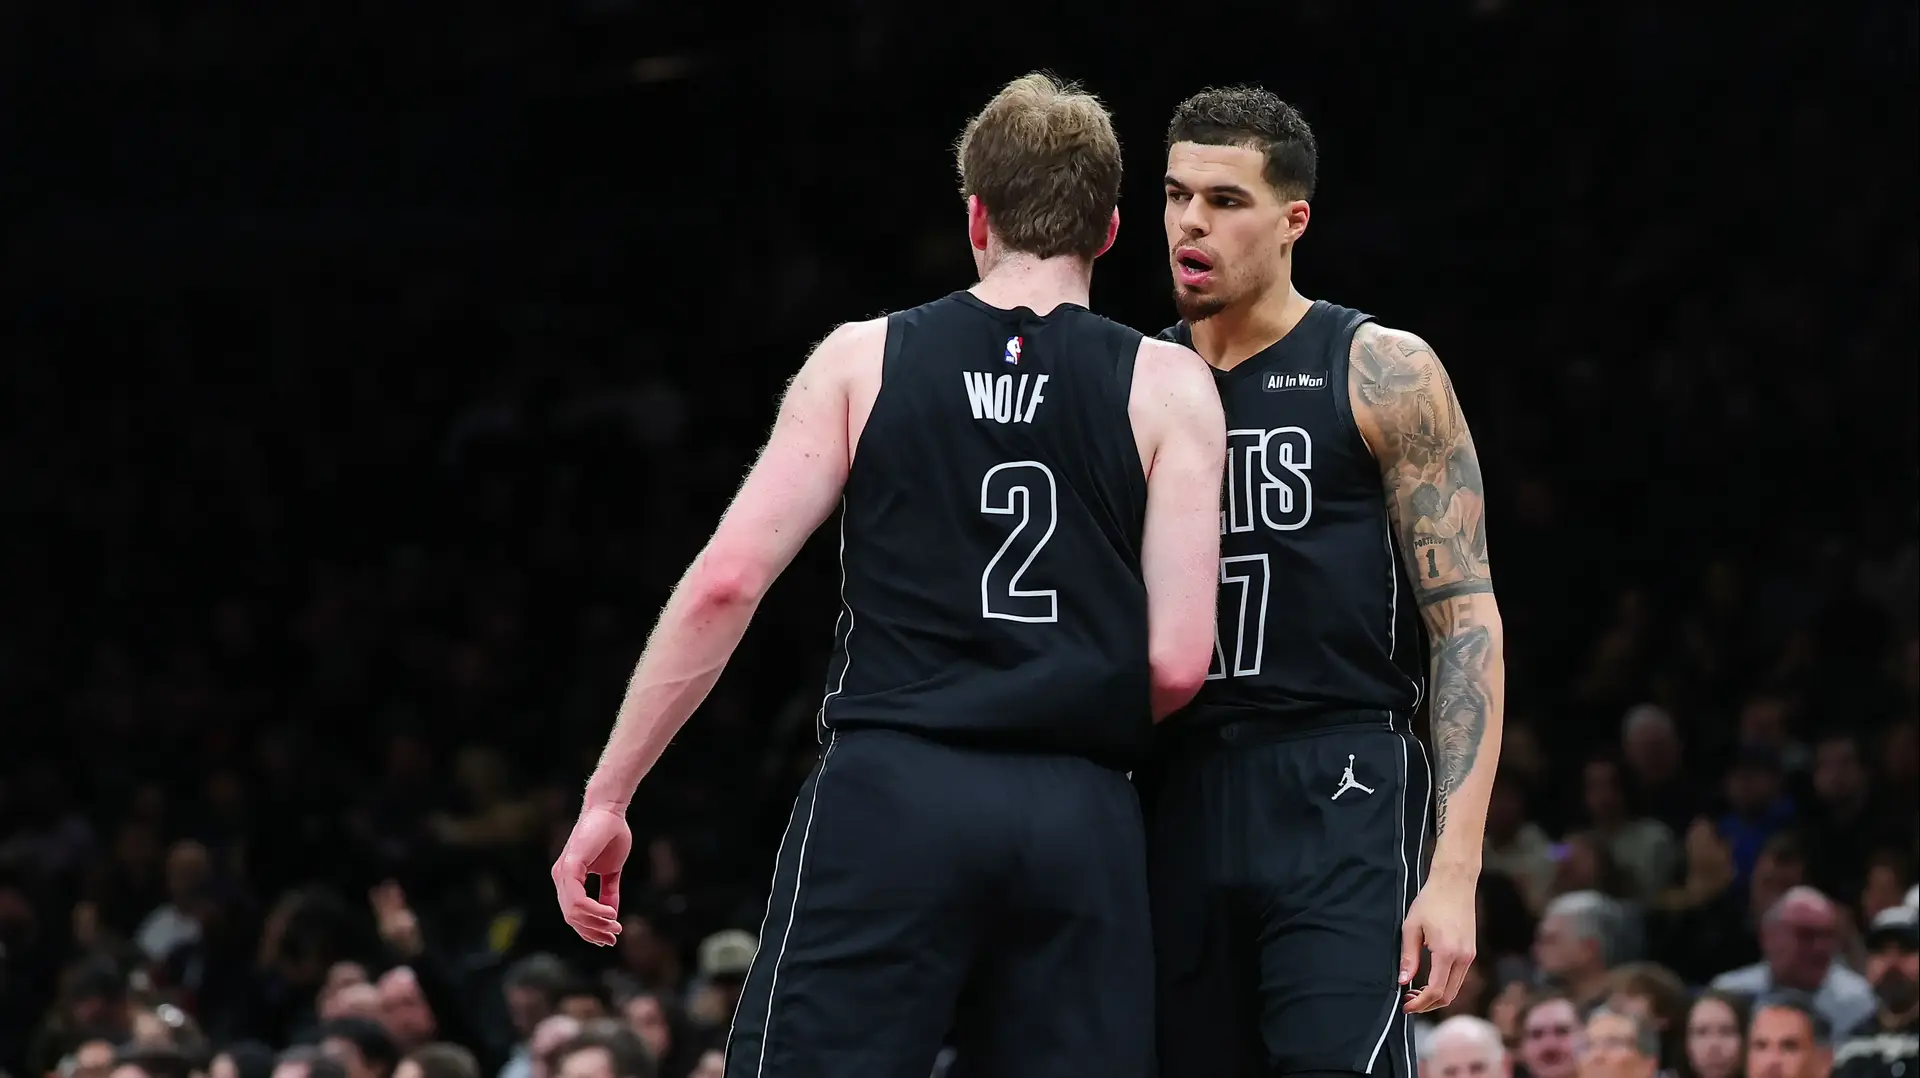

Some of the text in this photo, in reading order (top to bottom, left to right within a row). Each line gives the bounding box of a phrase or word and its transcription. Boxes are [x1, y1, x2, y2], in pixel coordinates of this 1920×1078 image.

[963, 371, 1050, 424] WOLF
[1267, 373, 1324, 389] All In Won
[1219, 426, 1312, 535] TS
[980, 460, 1058, 623] 2
[1426, 548, 1440, 579] 1
[1205, 553, 1271, 681] 7
